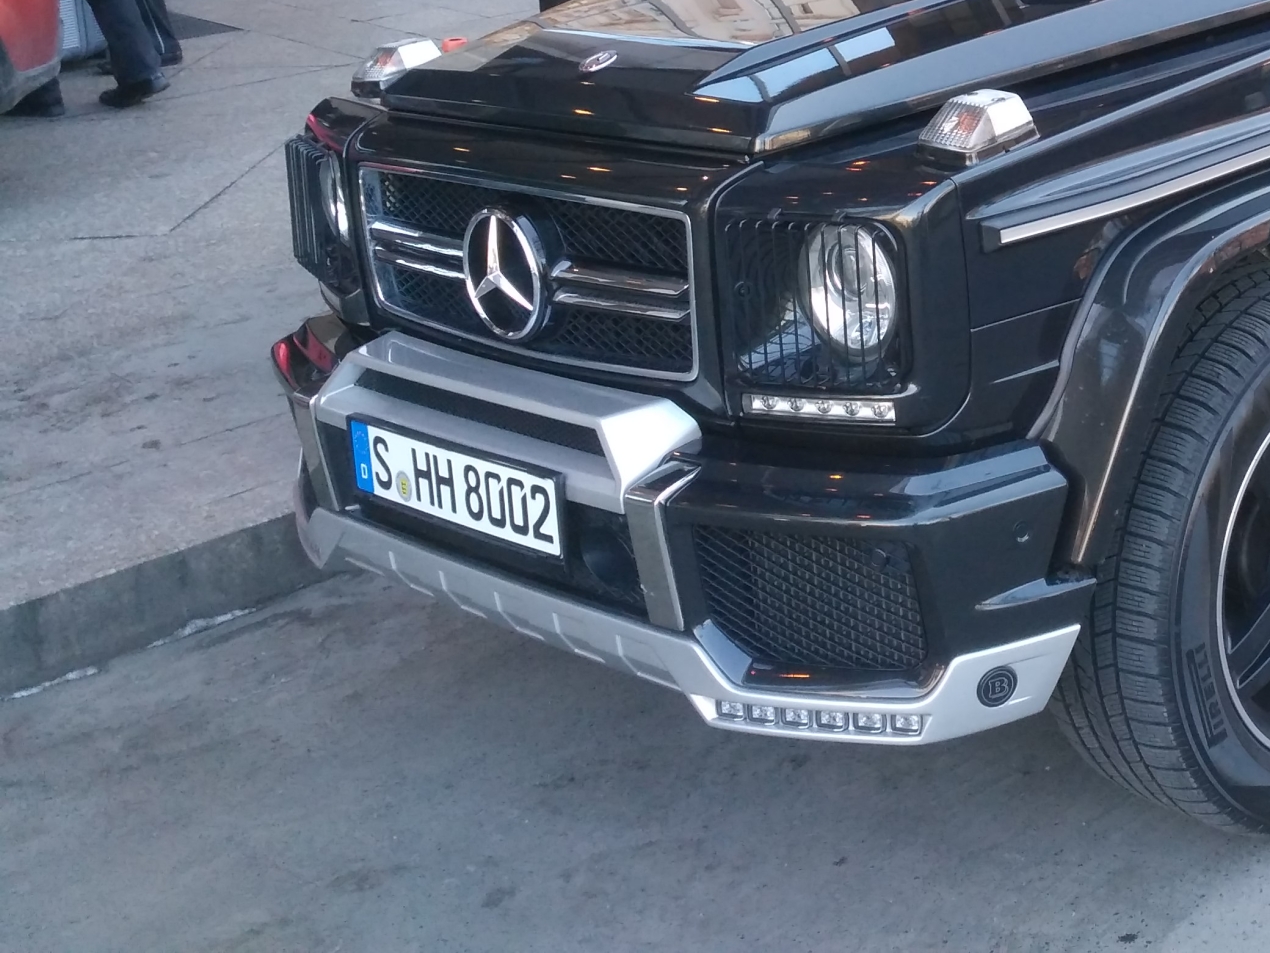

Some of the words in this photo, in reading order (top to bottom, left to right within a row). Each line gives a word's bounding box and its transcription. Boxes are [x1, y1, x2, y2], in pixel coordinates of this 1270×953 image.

[361, 464, 368, 479] D
[373, 435, 393, 491] S
[411, 448, 457, 514] HH
[463, 464, 554, 544] 8002
[1186, 642, 1228, 749] PIRELLI
